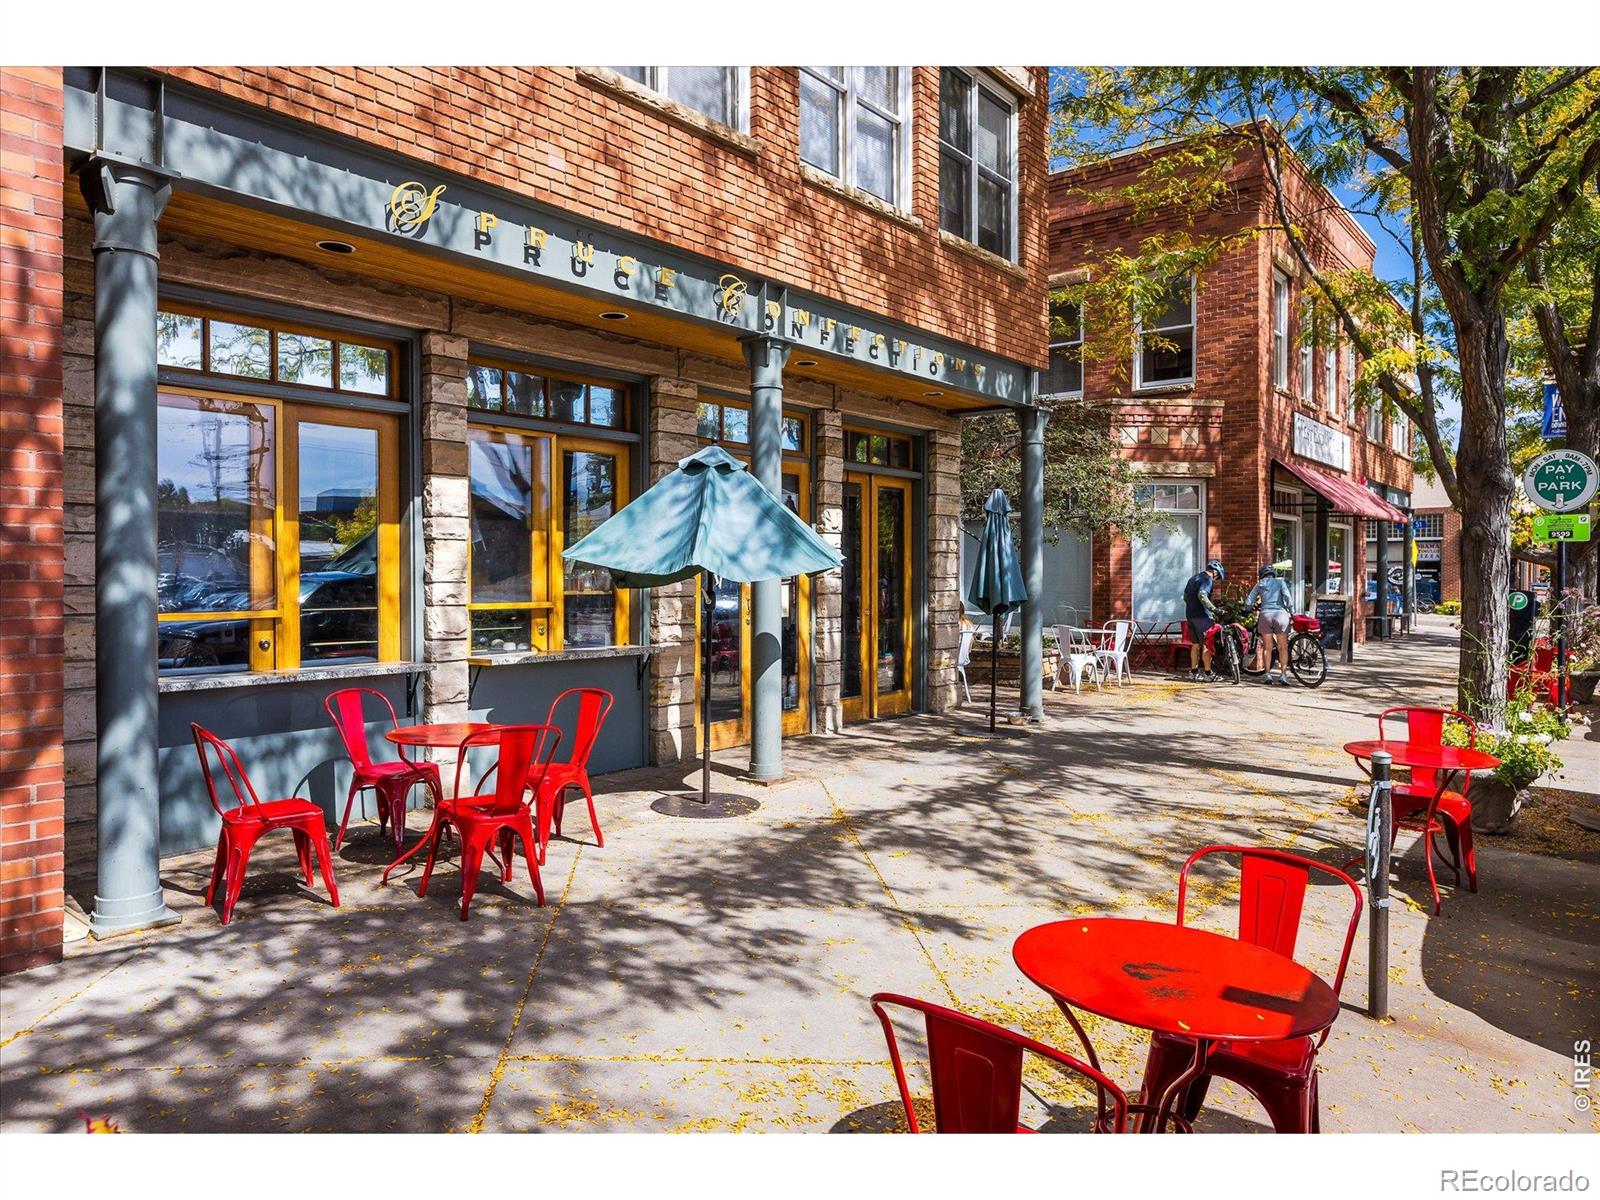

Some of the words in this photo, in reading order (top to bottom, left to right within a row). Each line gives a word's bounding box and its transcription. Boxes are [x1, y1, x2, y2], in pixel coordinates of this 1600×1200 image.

[391, 181, 676, 290] SPRUCE
[718, 273, 985, 377] CONFECTIONS
[1545, 464, 1575, 475] PAY
[1538, 481, 1582, 491] PARK
